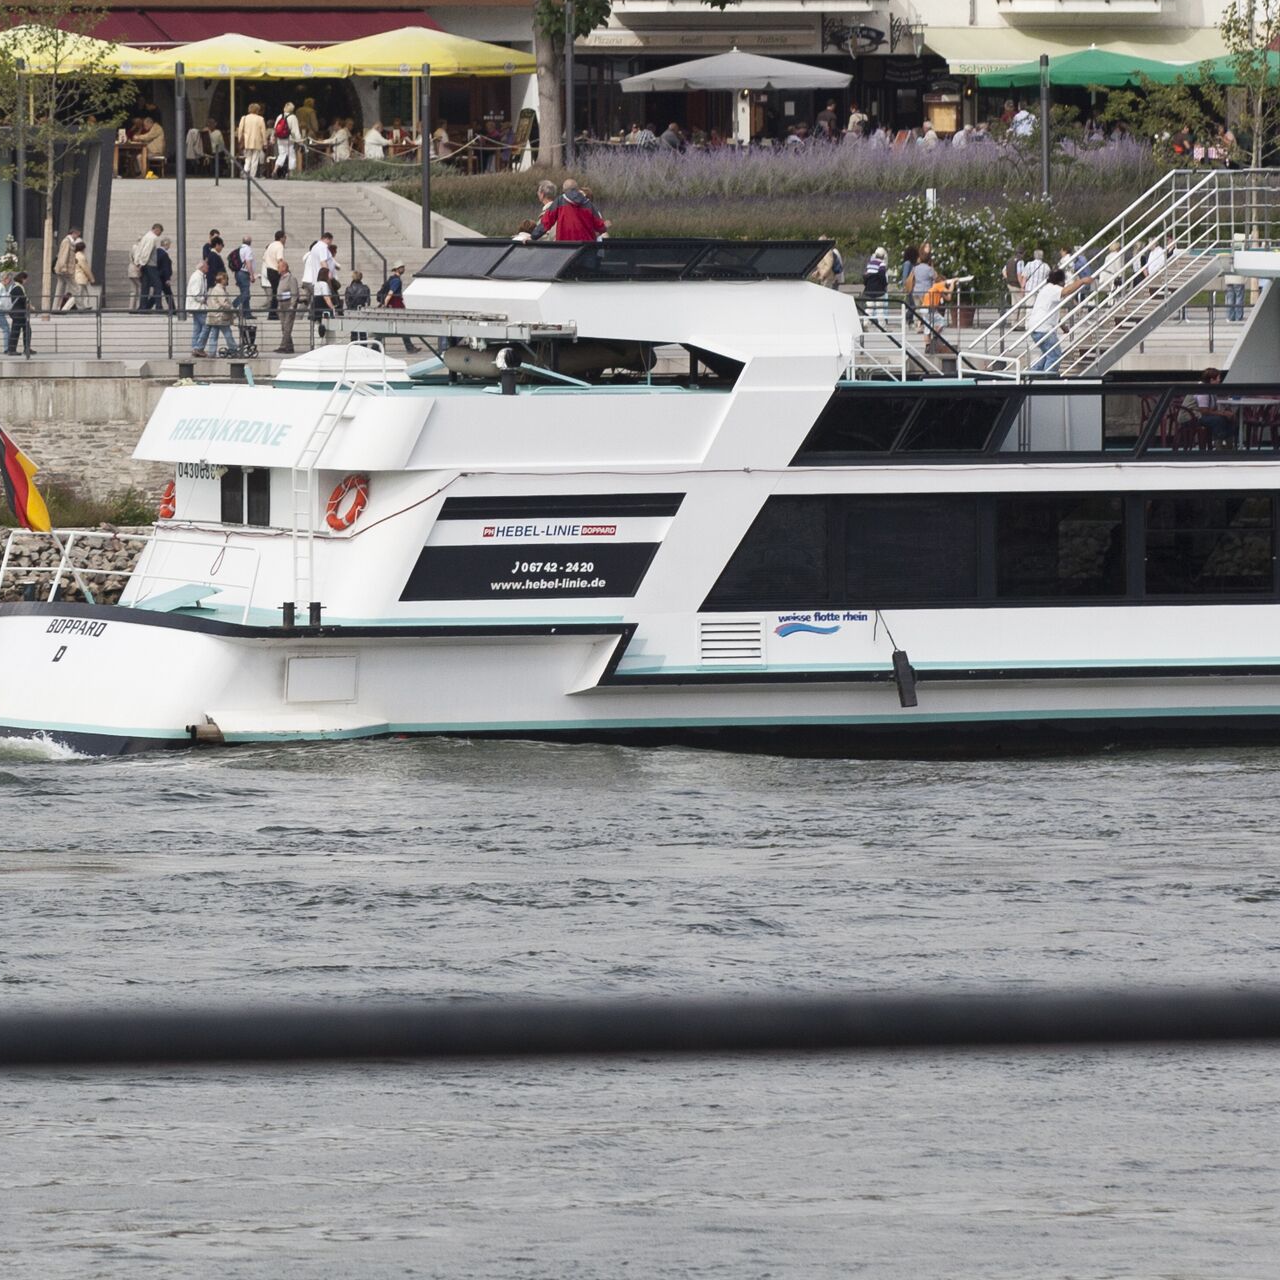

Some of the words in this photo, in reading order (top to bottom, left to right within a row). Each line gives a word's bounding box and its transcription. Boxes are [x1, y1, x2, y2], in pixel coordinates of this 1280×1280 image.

[168, 418, 292, 446] RHEINKRONE
[496, 525, 580, 536] HEBEL-LINIE
[582, 526, 616, 535] BOPPARD
[490, 577, 606, 591] www.hebel-linie.de
[778, 613, 811, 622] weisse
[814, 612, 840, 621] flotte
[843, 612, 868, 621] rhein
[46, 619, 108, 637] BOPPARD
[52, 645, 68, 662] D
